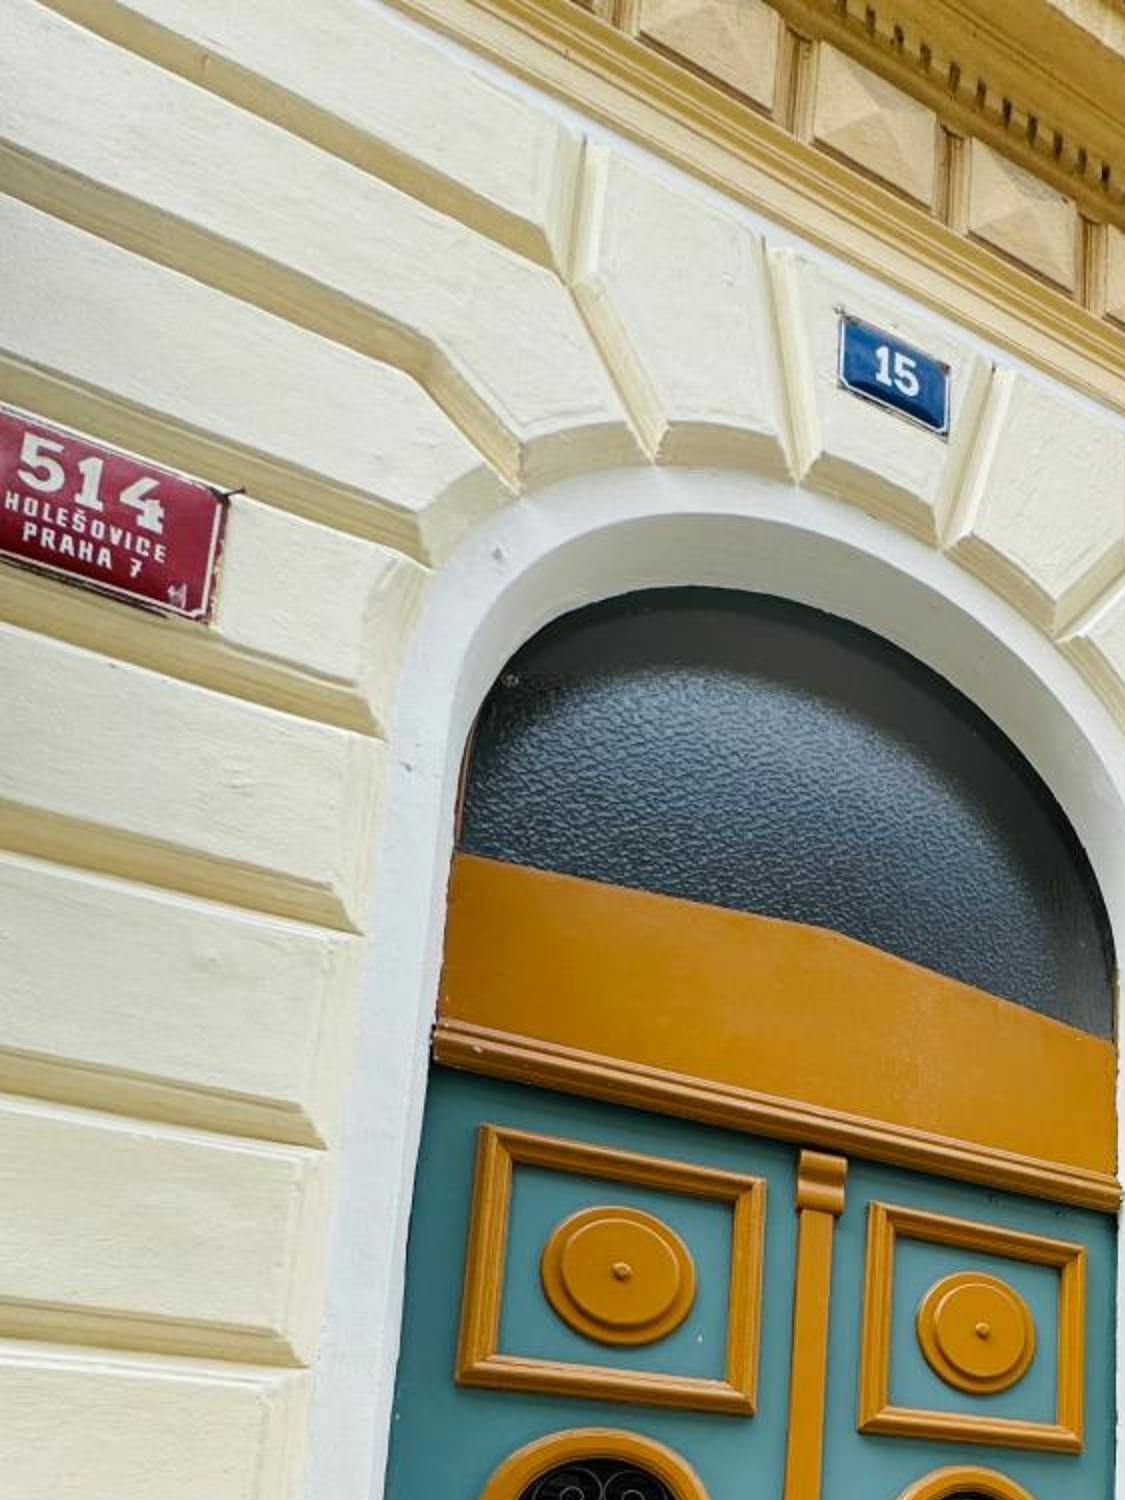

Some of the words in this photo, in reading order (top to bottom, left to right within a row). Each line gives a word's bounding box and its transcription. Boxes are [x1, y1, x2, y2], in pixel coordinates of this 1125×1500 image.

[875, 345, 919, 397] 15
[17, 431, 165, 535] 514
[4, 490, 168, 564] HOLEŠOVICE
[22, 521, 113, 570] PRAHA
[129, 557, 143, 578] 7
